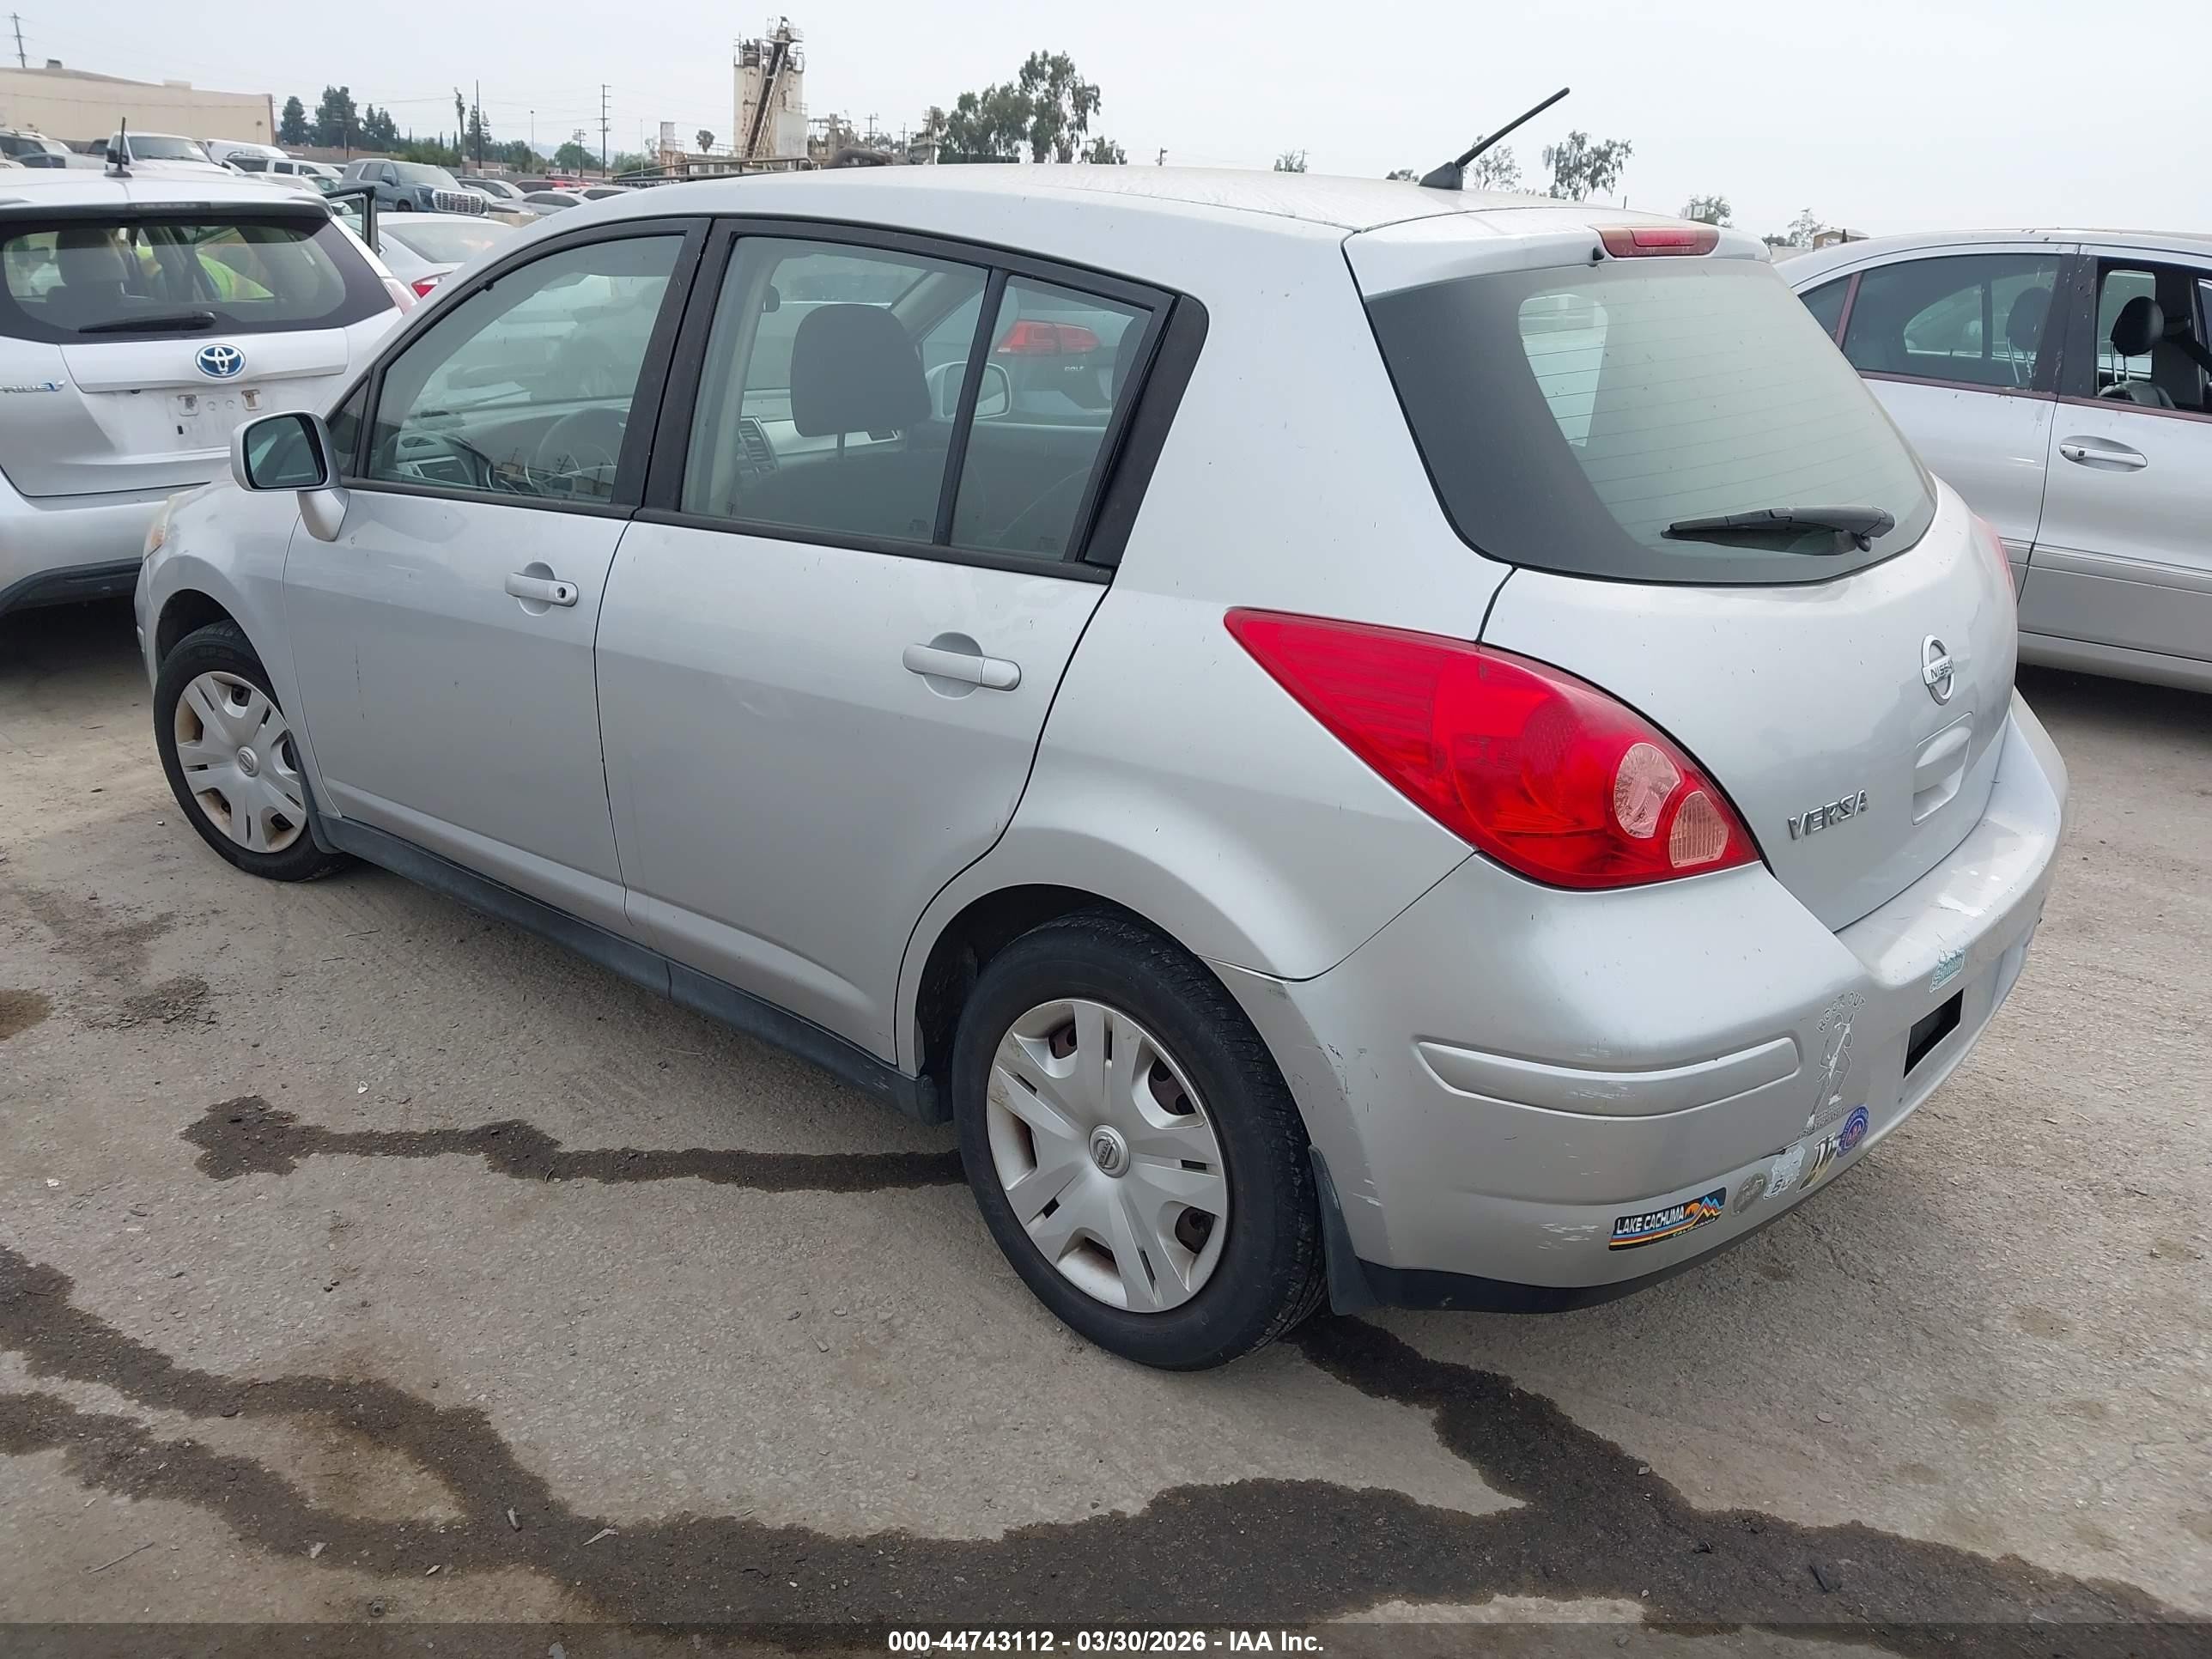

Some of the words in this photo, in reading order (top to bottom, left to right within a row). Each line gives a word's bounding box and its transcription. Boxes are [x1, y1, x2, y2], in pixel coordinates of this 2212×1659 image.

[1787, 789, 1869, 841] VERSA
[1616, 1218, 1643, 1235] LAKE
[1644, 1205, 1685, 1231] CACHUMA
[1672, 1217, 1716, 1237] CALIFORNIA
